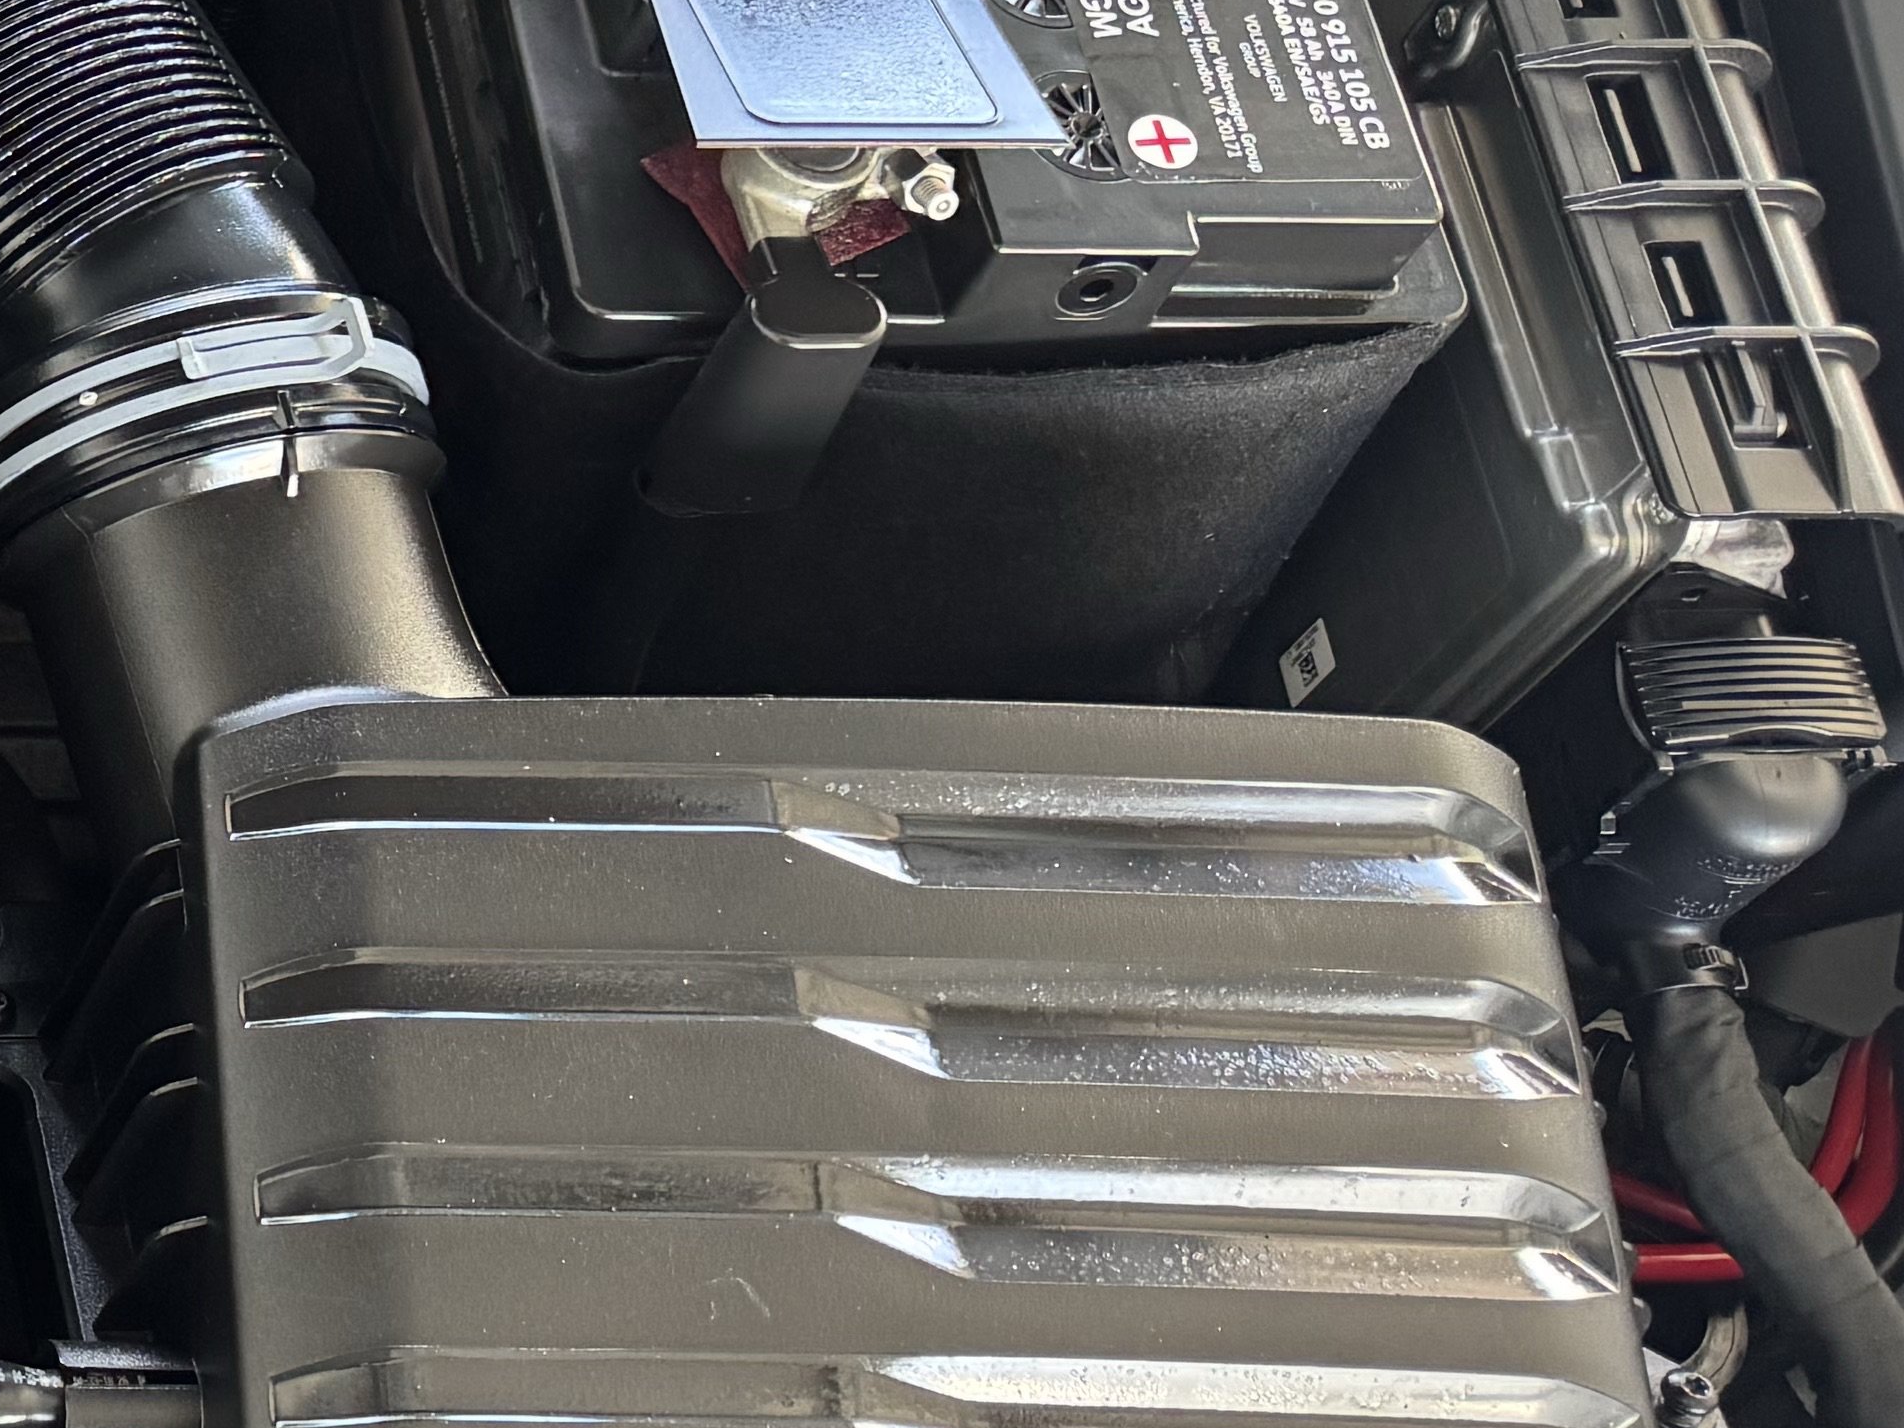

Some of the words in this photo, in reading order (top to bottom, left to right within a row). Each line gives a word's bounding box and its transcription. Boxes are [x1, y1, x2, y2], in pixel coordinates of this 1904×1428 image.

[1203, 35, 1225, 55] for
[1237, 42, 1262, 77] GROUP
[1240, 14, 1289, 102] VOLKSWAGEN
[1317, 18, 1361, 63] 915
[1182, 37, 1220, 94] Herndon,
[1280, 37, 1332, 125] EN/SAE/GS
[1206, 56, 1253, 131] Volkswagen
[1206, 96, 1226, 115] VA
[1313, 70, 1347, 113] 340A
[1330, 115, 1360, 145] DIN
[1335, 68, 1380, 112] 105
[1213, 117, 1243, 158] 20171
[1235, 133, 1269, 173] Group
[1354, 116, 1393, 149] CB
